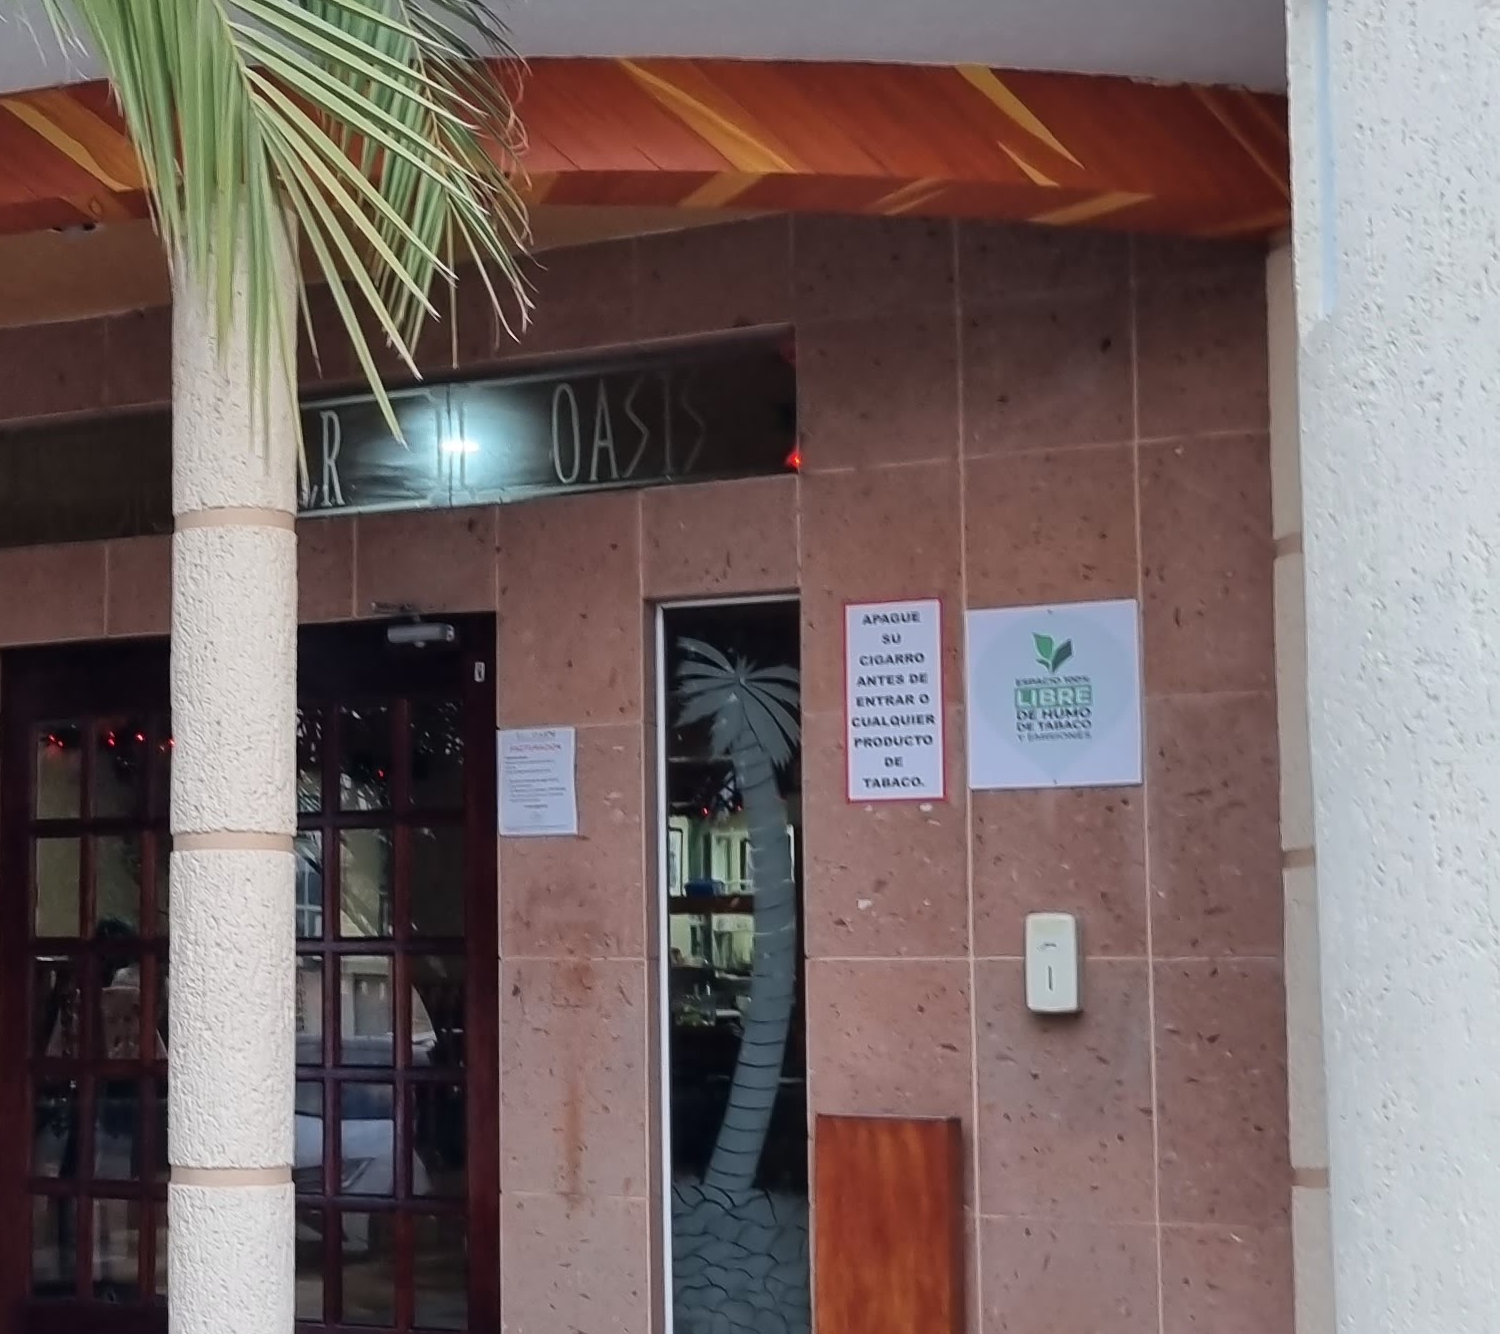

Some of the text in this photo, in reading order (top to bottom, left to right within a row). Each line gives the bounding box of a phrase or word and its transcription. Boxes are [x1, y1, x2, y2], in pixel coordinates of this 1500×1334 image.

[552, 370, 707, 483] OASIS
[862, 611, 921, 625] APAGUE
[881, 633, 901, 645] SU
[859, 652, 925, 666] CIGARRO
[856, 673, 928, 687] ANTES DE
[855, 693, 930, 707] ENTRAR O
[1017, 687, 1091, 707] LIBRE
[851, 714, 936, 727] CUALQUIER
[1017, 707, 1091, 721] DE HUMO
[1017, 719, 1092, 731] DE TABACO
[853, 734, 933, 748] PRODUCTO
[884, 756, 903, 768] DE
[862, 776, 925, 788] TABACO.
